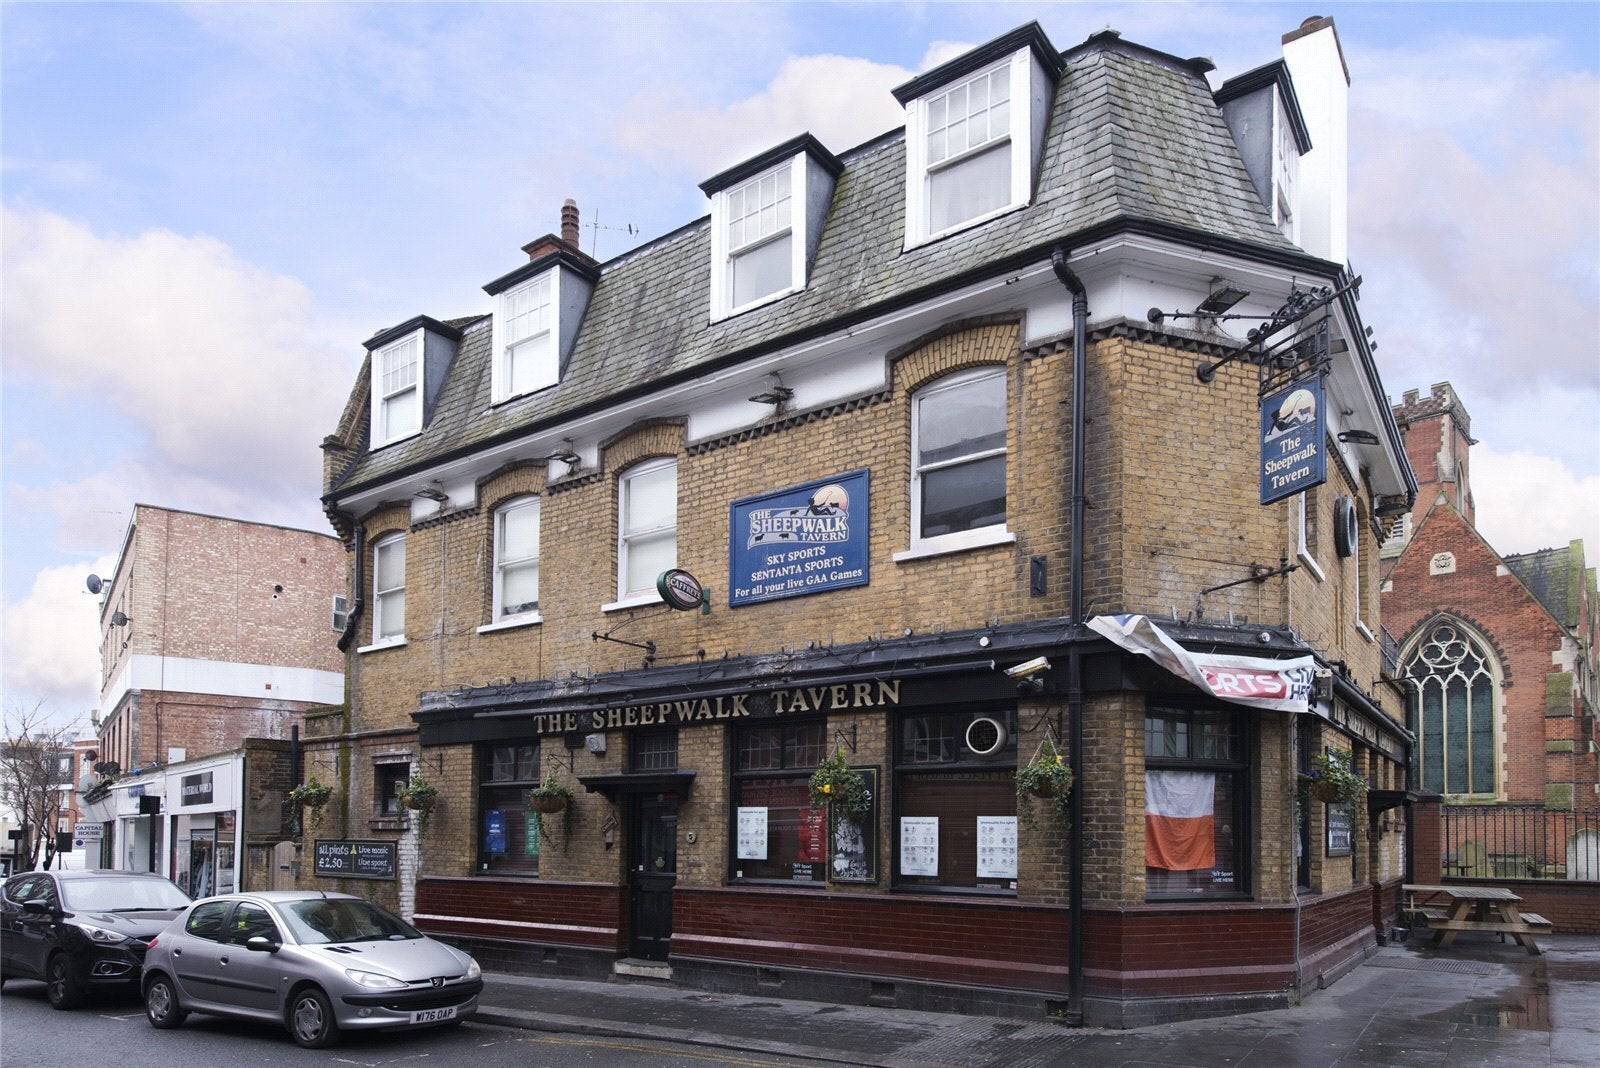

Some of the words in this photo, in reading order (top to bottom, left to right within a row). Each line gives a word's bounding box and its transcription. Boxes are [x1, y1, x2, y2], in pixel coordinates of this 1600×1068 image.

[1280, 437, 1301, 453] The
[1265, 443, 1317, 475] Sheepwalk
[1271, 466, 1309, 489] Tavern
[751, 511, 771, 521] THE
[751, 516, 848, 534] SHEEPWALK
[800, 531, 846, 541] TAVERN
[767, 553, 786, 566] SKY
[788, 546, 826, 562] SPORTS
[751, 566, 802, 582] SENTANTA
[804, 556, 843, 573] SPORTS
[735, 588, 750, 598] For
[752, 585, 763, 595] all
[764, 583, 785, 596] your
[787, 579, 804, 589] live
[806, 576, 828, 586] GAA
[831, 569, 862, 581] Games
[534, 712, 578, 734] THE
[592, 694, 750, 729] SHEEPWALK
[771, 679, 901, 714] TAVERN
[319, 844, 329, 855] all
[329, 844, 349, 857] pints
[416, 1012, 435, 1021] W176
